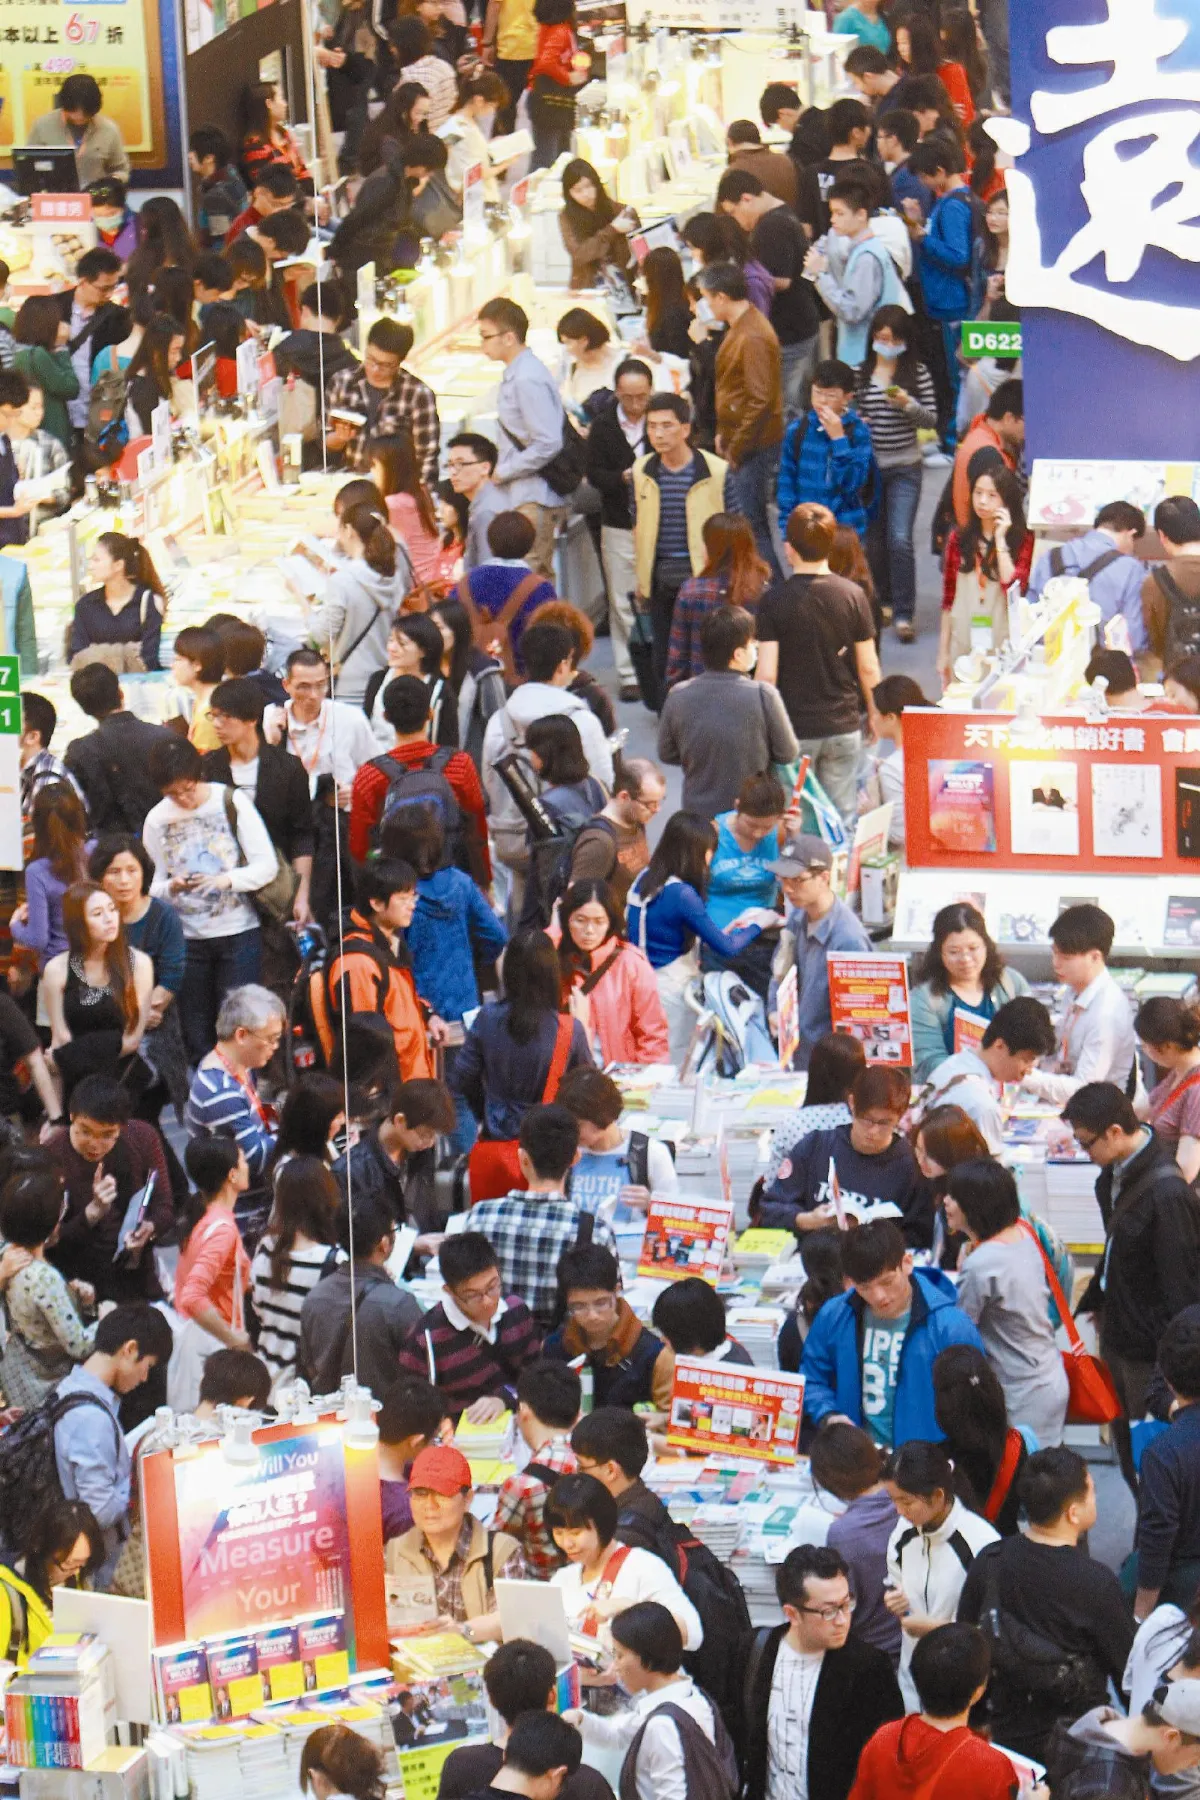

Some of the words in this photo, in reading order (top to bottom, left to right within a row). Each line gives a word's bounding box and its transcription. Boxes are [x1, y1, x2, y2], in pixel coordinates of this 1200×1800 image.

[969, 332, 1022, 350] D622
[284, 1451, 319, 1470] You
[199, 1525, 334, 1577] Measure
[237, 1581, 301, 1614] Your
